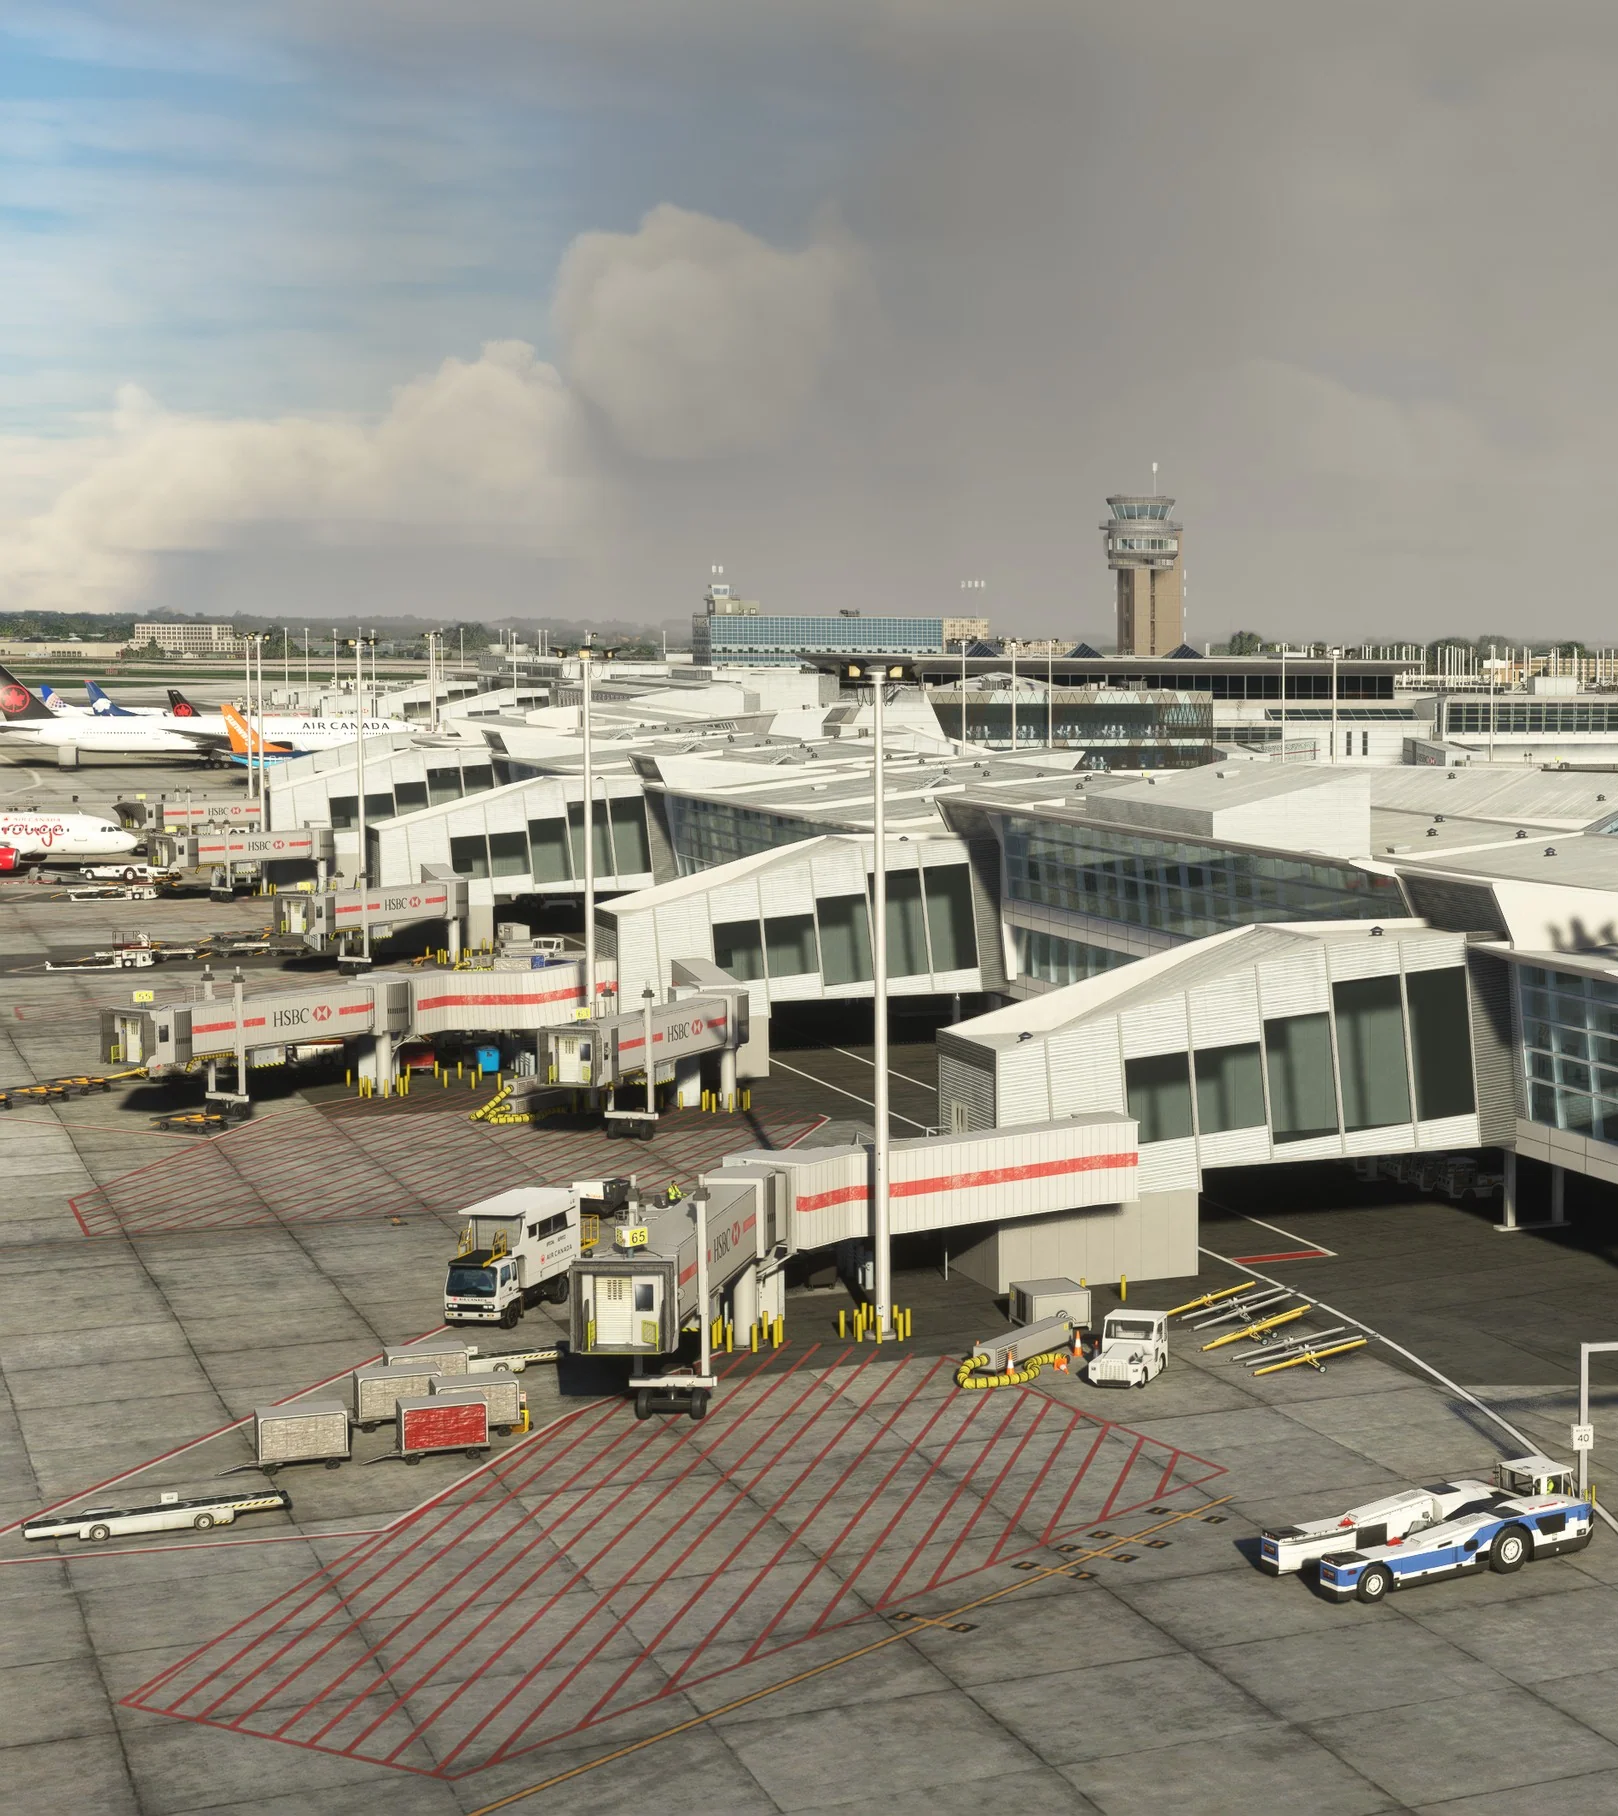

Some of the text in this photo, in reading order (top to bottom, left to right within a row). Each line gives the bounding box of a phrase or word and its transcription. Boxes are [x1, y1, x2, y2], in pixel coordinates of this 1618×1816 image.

[302, 722, 326, 730] AIR
[207, 806, 229, 816] HSBC
[2, 823, 65, 848] rouge
[248, 841, 271, 852] HSBC
[384, 897, 408, 911] HSBC
[273, 1007, 310, 1028] HSBC
[667, 1021, 690, 1043] HSBC
[631, 1230, 646, 1244] 65
[713, 1228, 731, 1263] HSBC
[1577, 1433, 1590, 1442] 40
